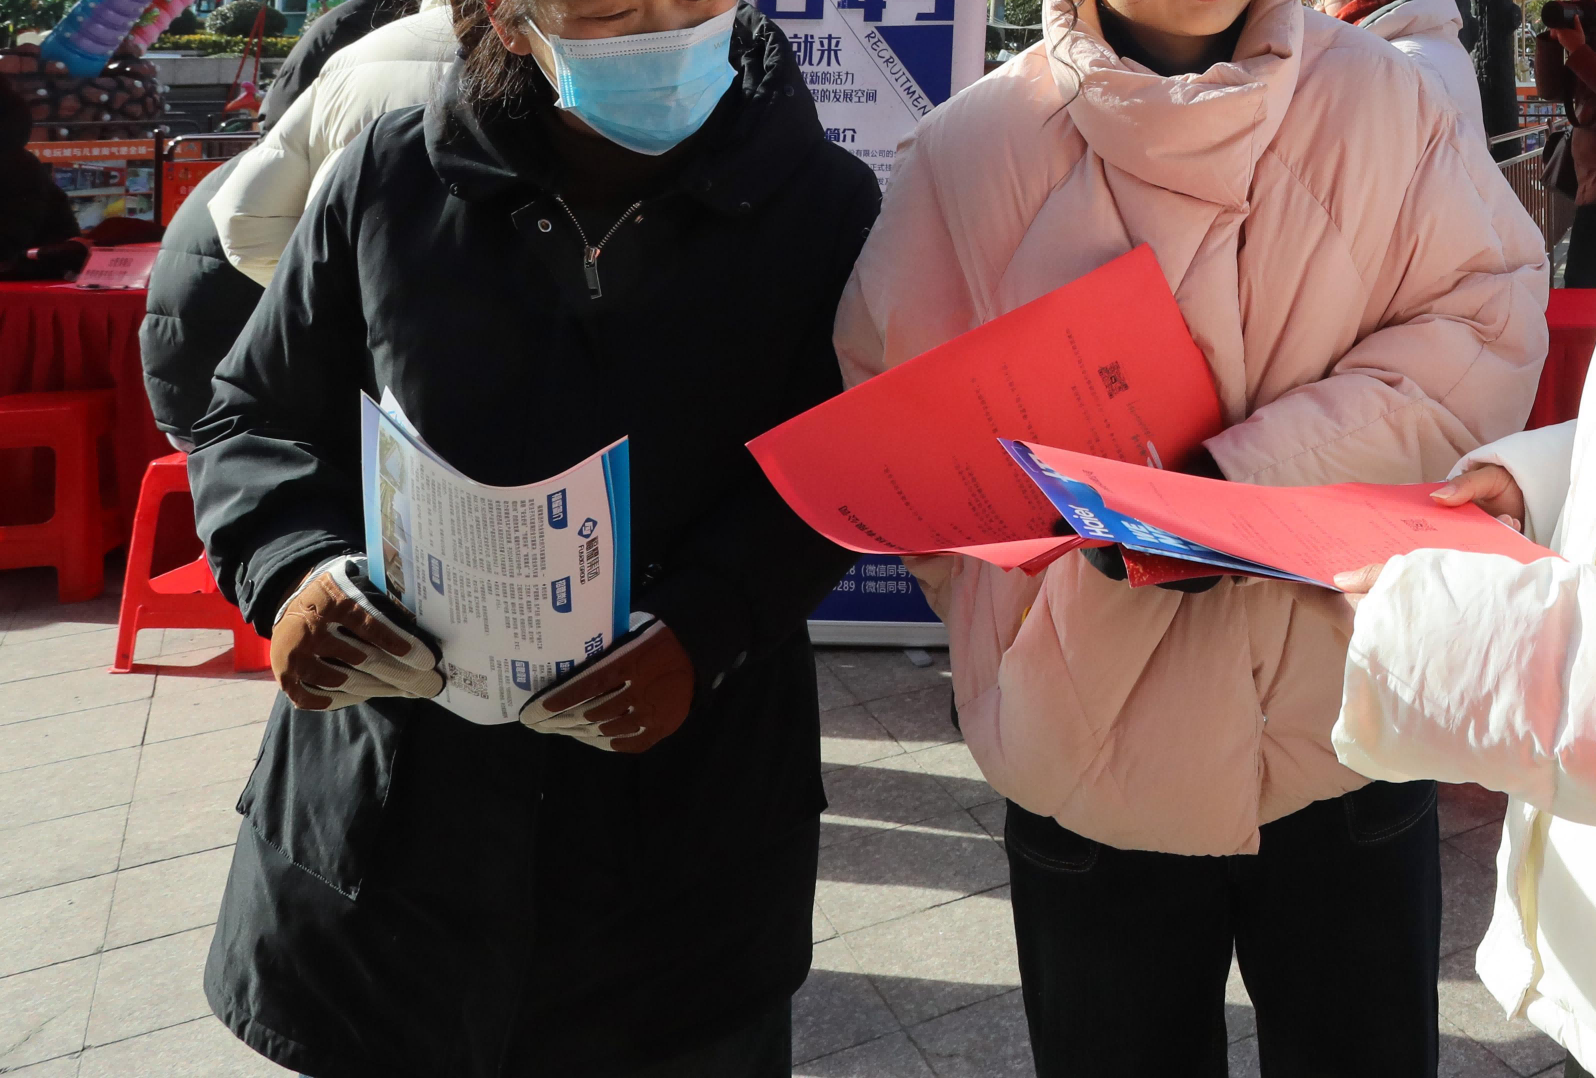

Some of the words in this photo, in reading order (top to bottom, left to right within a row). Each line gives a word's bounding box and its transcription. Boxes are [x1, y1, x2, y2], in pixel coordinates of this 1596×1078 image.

[867, 163, 893, 173] 正式挂
[1068, 504, 1114, 539] Haier
[1120, 520, 1156, 543] WE
